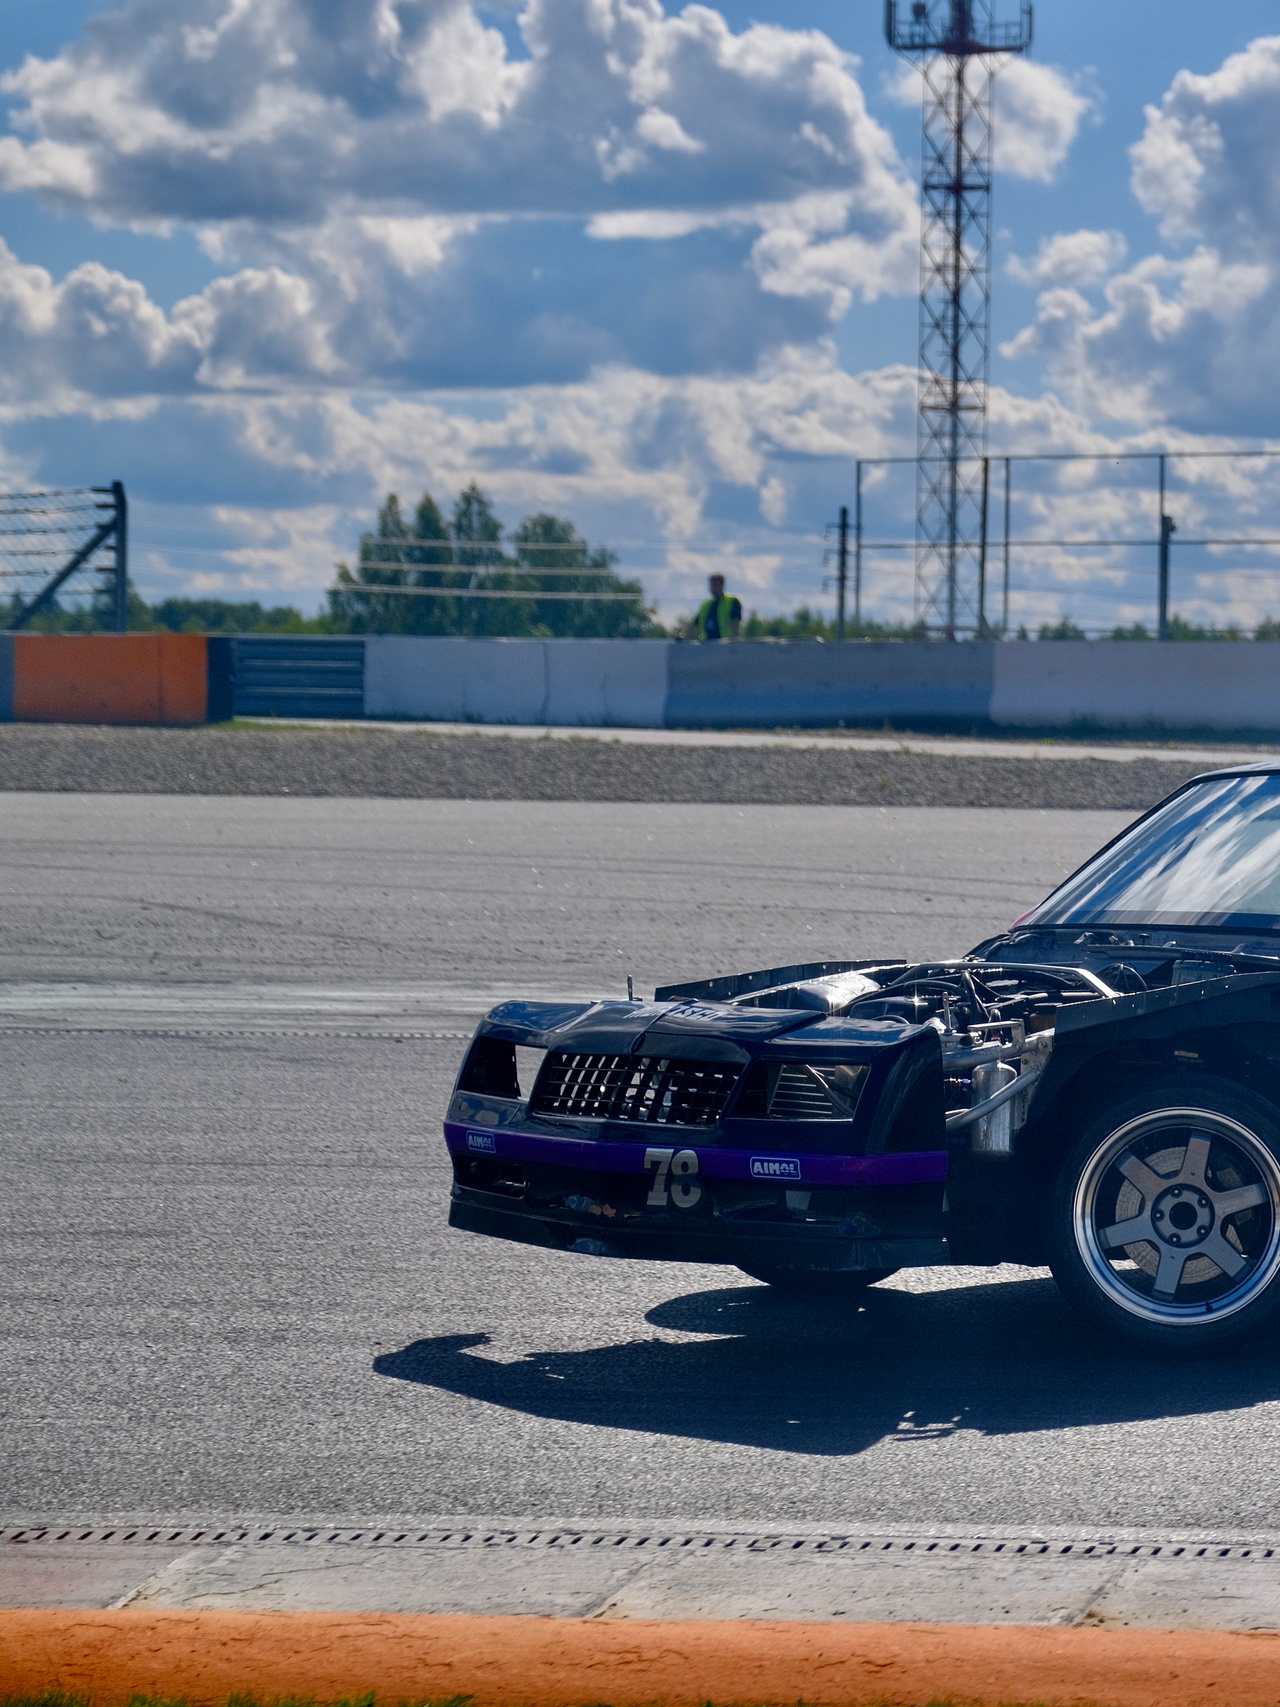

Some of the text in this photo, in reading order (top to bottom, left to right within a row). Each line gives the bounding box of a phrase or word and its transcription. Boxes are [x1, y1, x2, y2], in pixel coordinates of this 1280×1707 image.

[467, 1134, 494, 1148] AIMOL
[752, 1160, 798, 1175] AIMOL
[643, 1147, 701, 1208] 78
